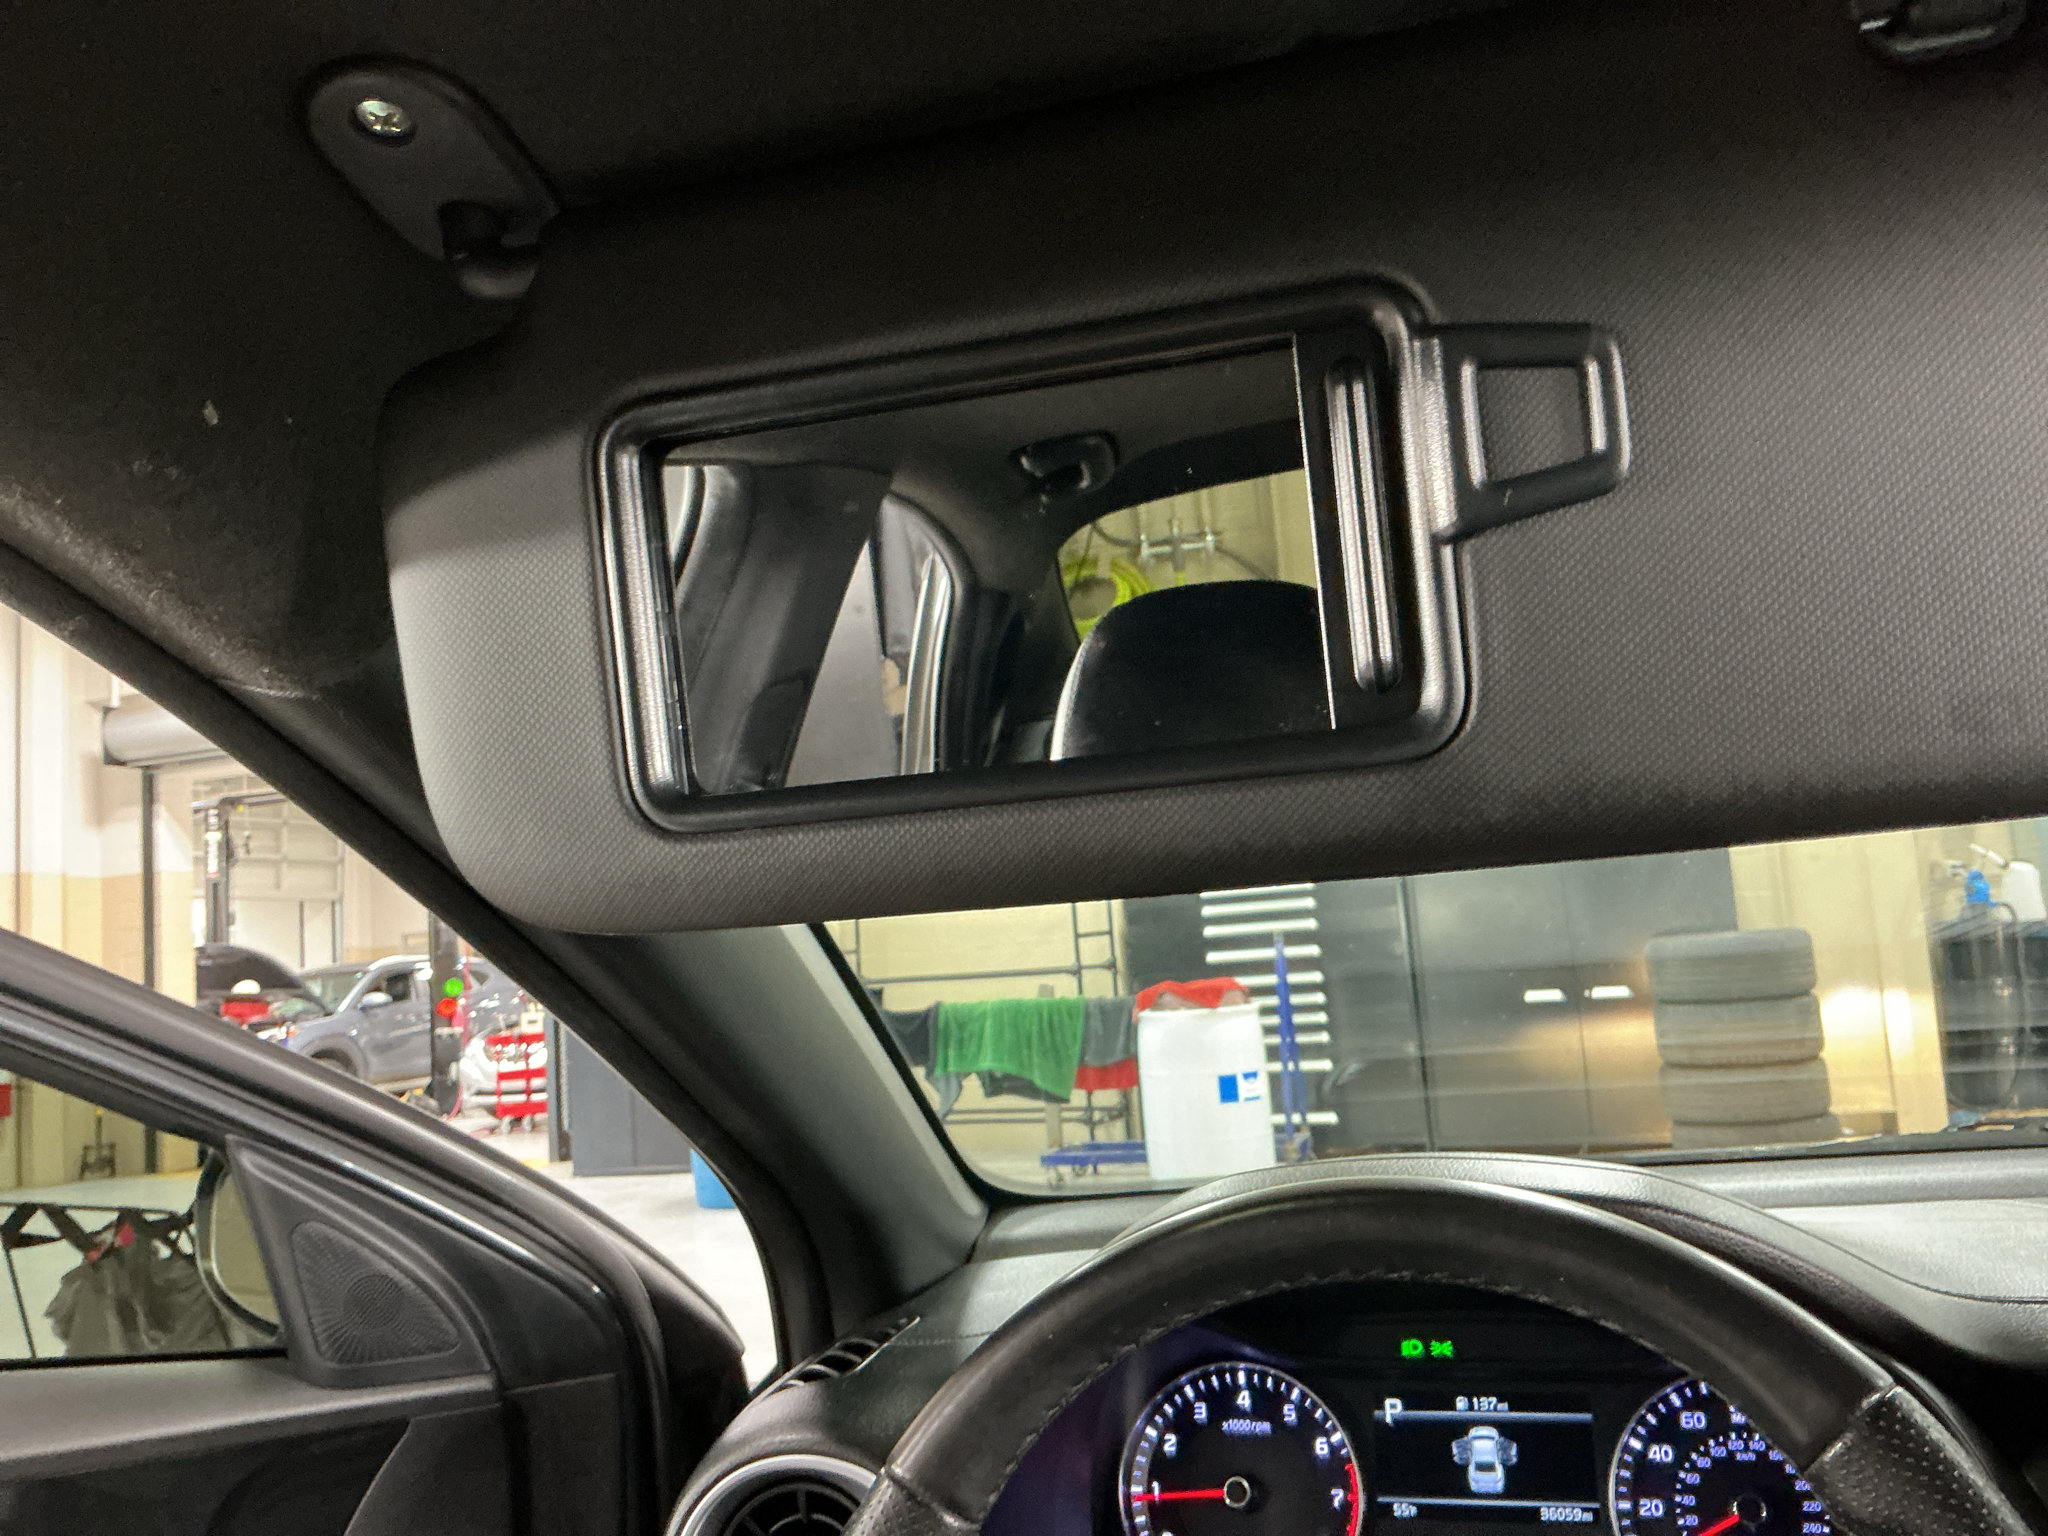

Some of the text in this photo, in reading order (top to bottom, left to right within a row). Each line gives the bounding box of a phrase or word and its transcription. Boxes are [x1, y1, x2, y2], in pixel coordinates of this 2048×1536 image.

[1236, 1389, 1251, 1411] 4
[1193, 1402, 1208, 1421] 3
[1283, 1403, 1297, 1424] 5
[1384, 1398, 1403, 1425] P
[1680, 1411, 1707, 1430] 60
[1163, 1433, 1178, 1455] 2
[1315, 1437, 1329, 1455] 6
[1648, 1444, 1674, 1462] 40
[1330, 1488, 1345, 1509] 7
[1639, 1499, 1665, 1517] 20
[1802, 1501, 1822, 1512] 220
[1802, 1523, 1822, 1534] 240
